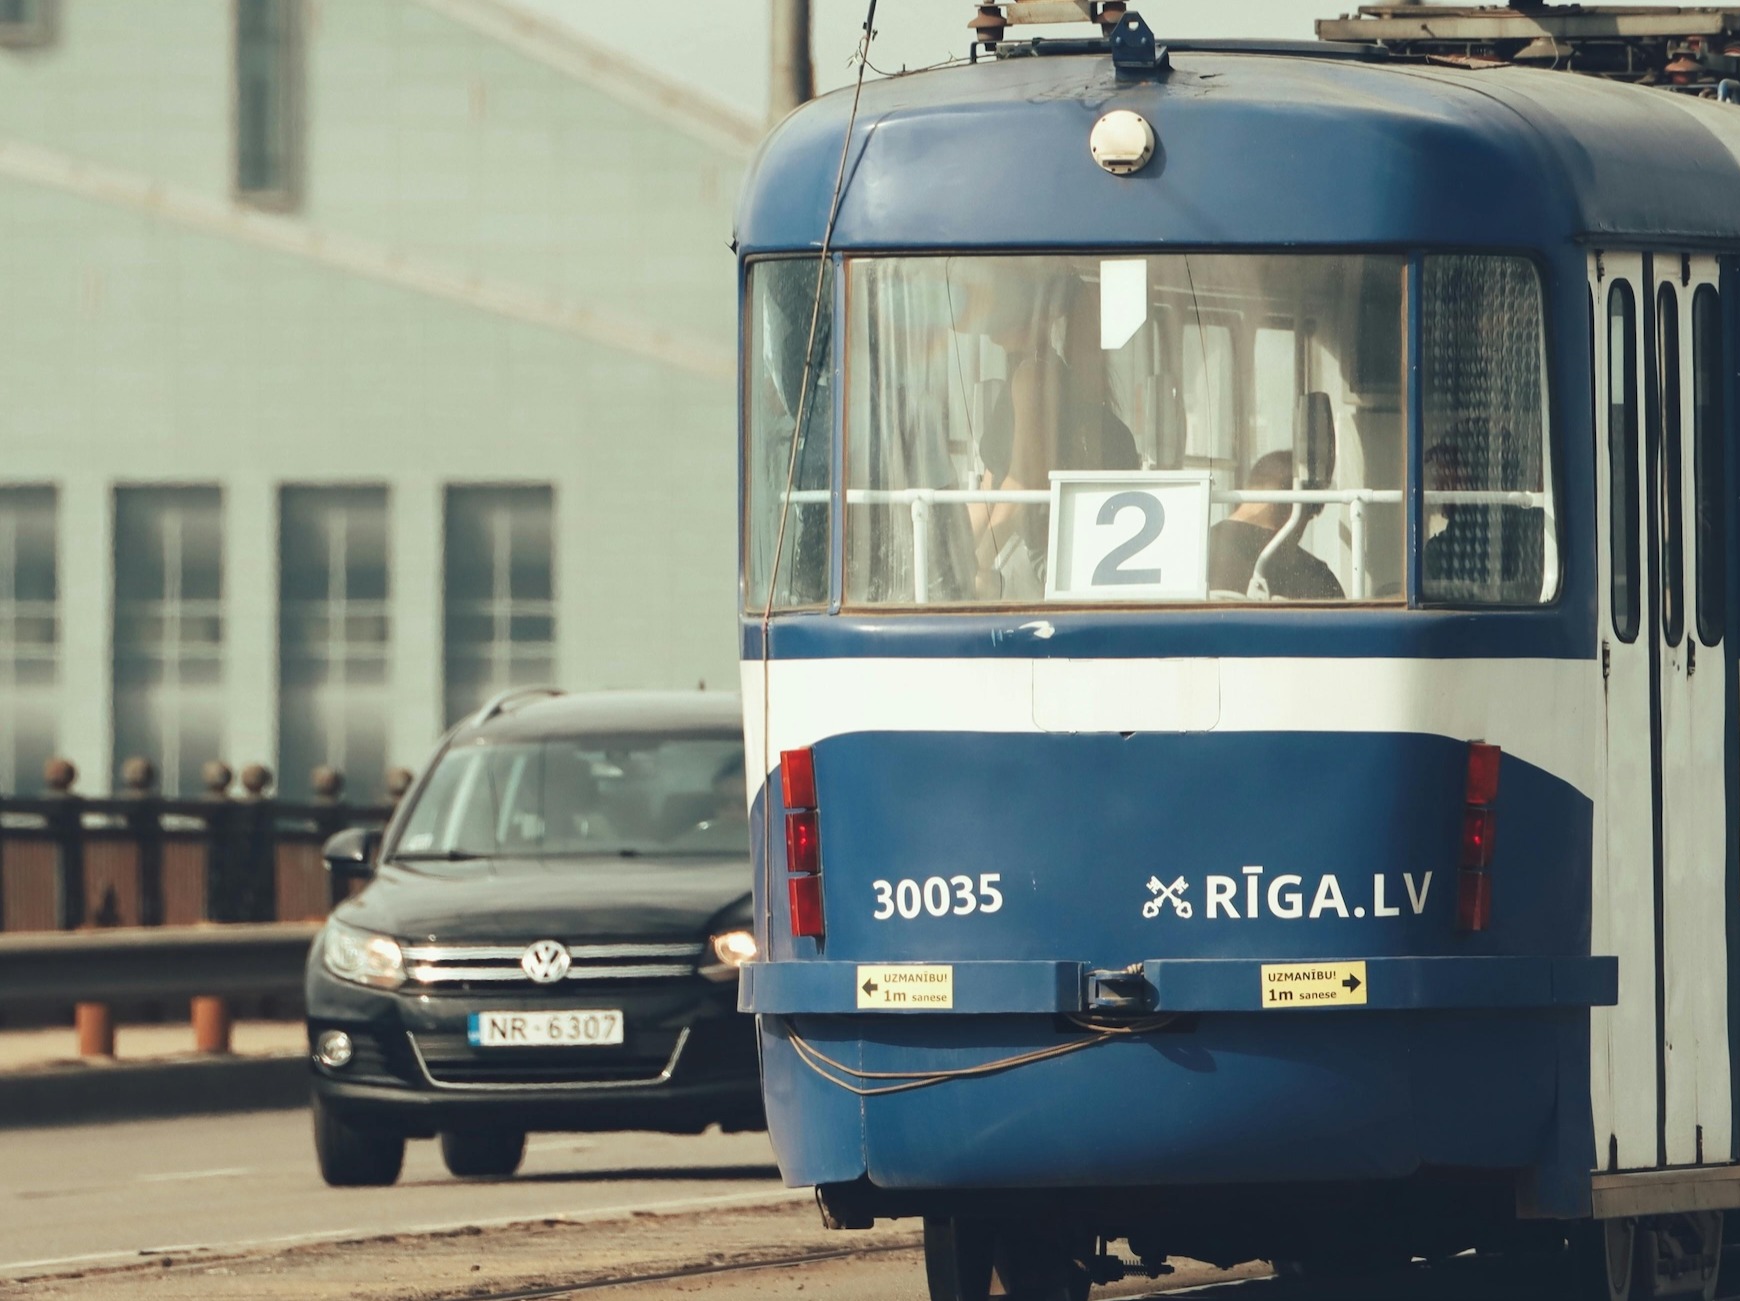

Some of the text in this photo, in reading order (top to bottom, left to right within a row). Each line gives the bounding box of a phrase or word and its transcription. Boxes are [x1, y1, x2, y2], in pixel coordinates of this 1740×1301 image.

[1091, 491, 1165, 586] 2
[872, 873, 1003, 920] 30035
[1206, 866, 1433, 919] RĪGA.LV
[884, 970, 947, 983] UZMANĪBU!
[1268, 968, 1336, 982] UZMANĪBU!
[884, 990, 947, 1002] 1m sanese
[1269, 988, 1337, 1001] 1m sanese
